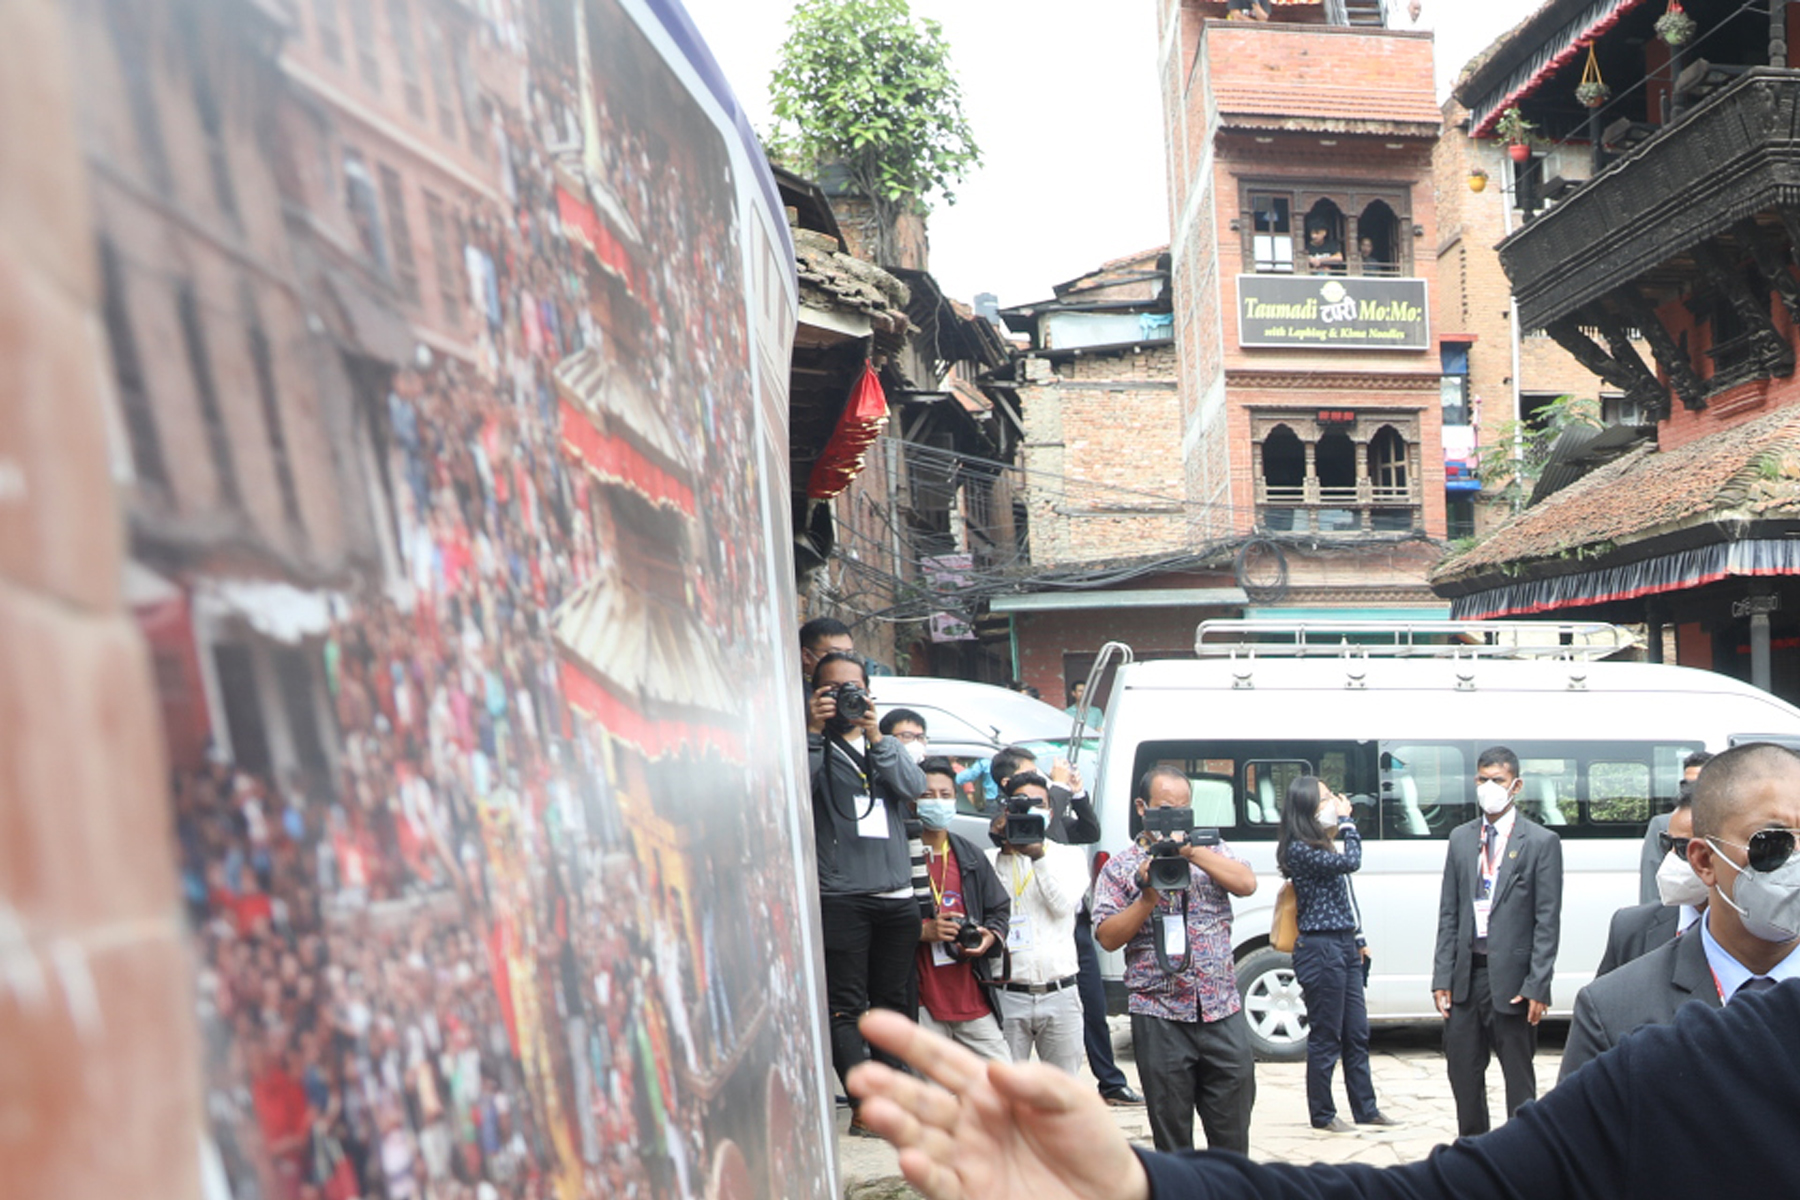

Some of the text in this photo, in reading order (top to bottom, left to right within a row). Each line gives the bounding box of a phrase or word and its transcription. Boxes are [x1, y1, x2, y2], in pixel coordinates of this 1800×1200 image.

[1244, 297, 1318, 319] Taumadi
[1264, 326, 1286, 337] with
[1328, 327, 1338, 338] &
[1368, 328, 1406, 340] Noodles
